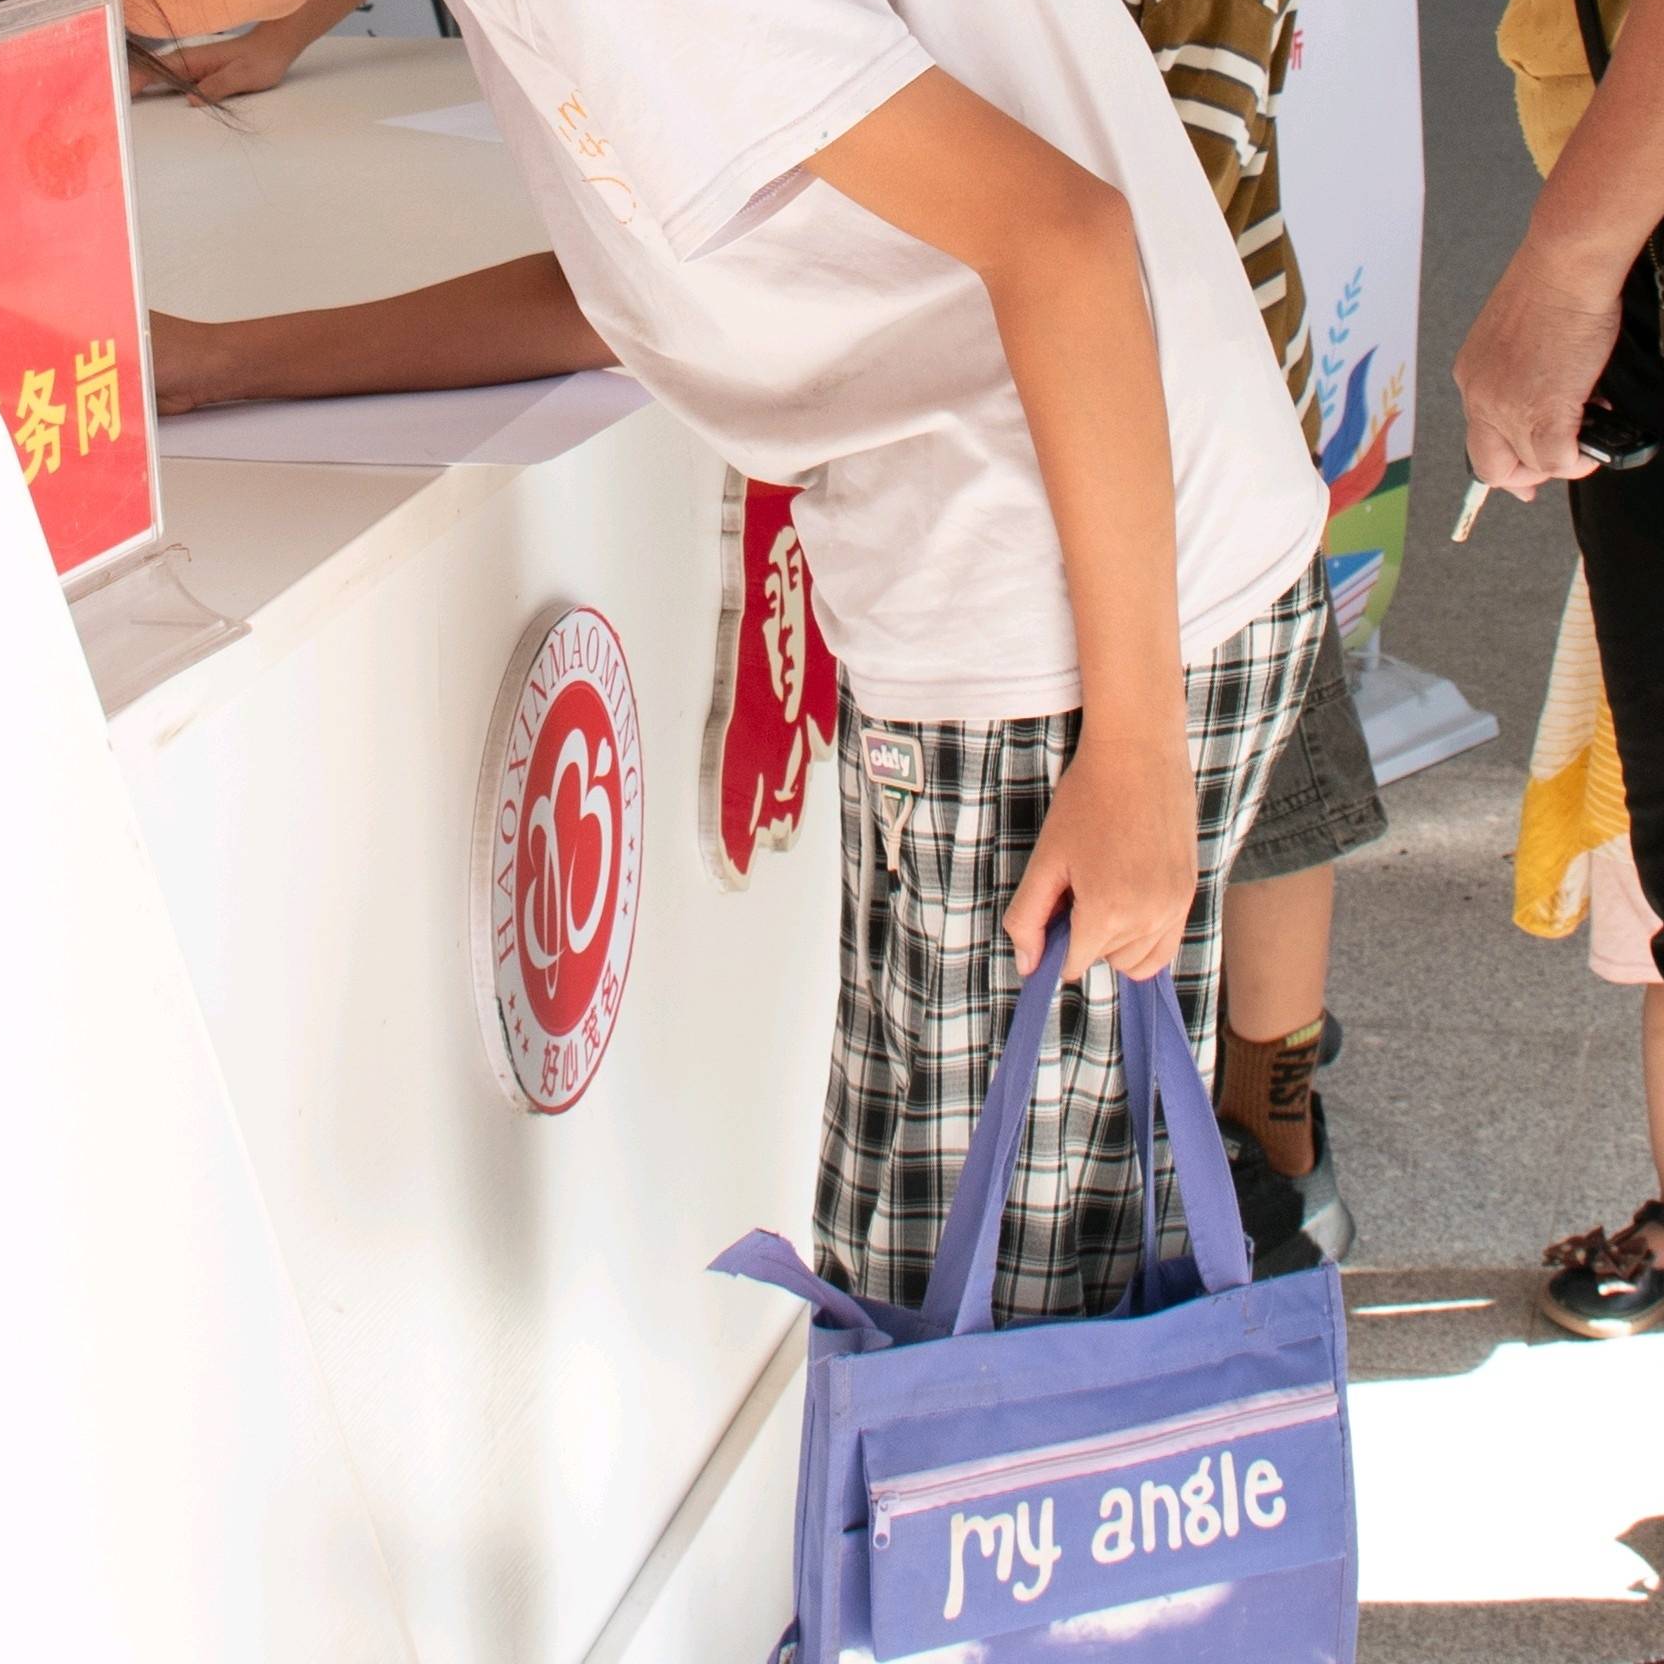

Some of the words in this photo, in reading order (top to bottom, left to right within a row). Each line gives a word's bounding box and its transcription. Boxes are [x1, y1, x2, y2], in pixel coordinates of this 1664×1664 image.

[539, 961, 621, 1096] 好心茂名
[942, 1497, 1062, 1621] my
[1090, 1449, 1288, 1565] angle
